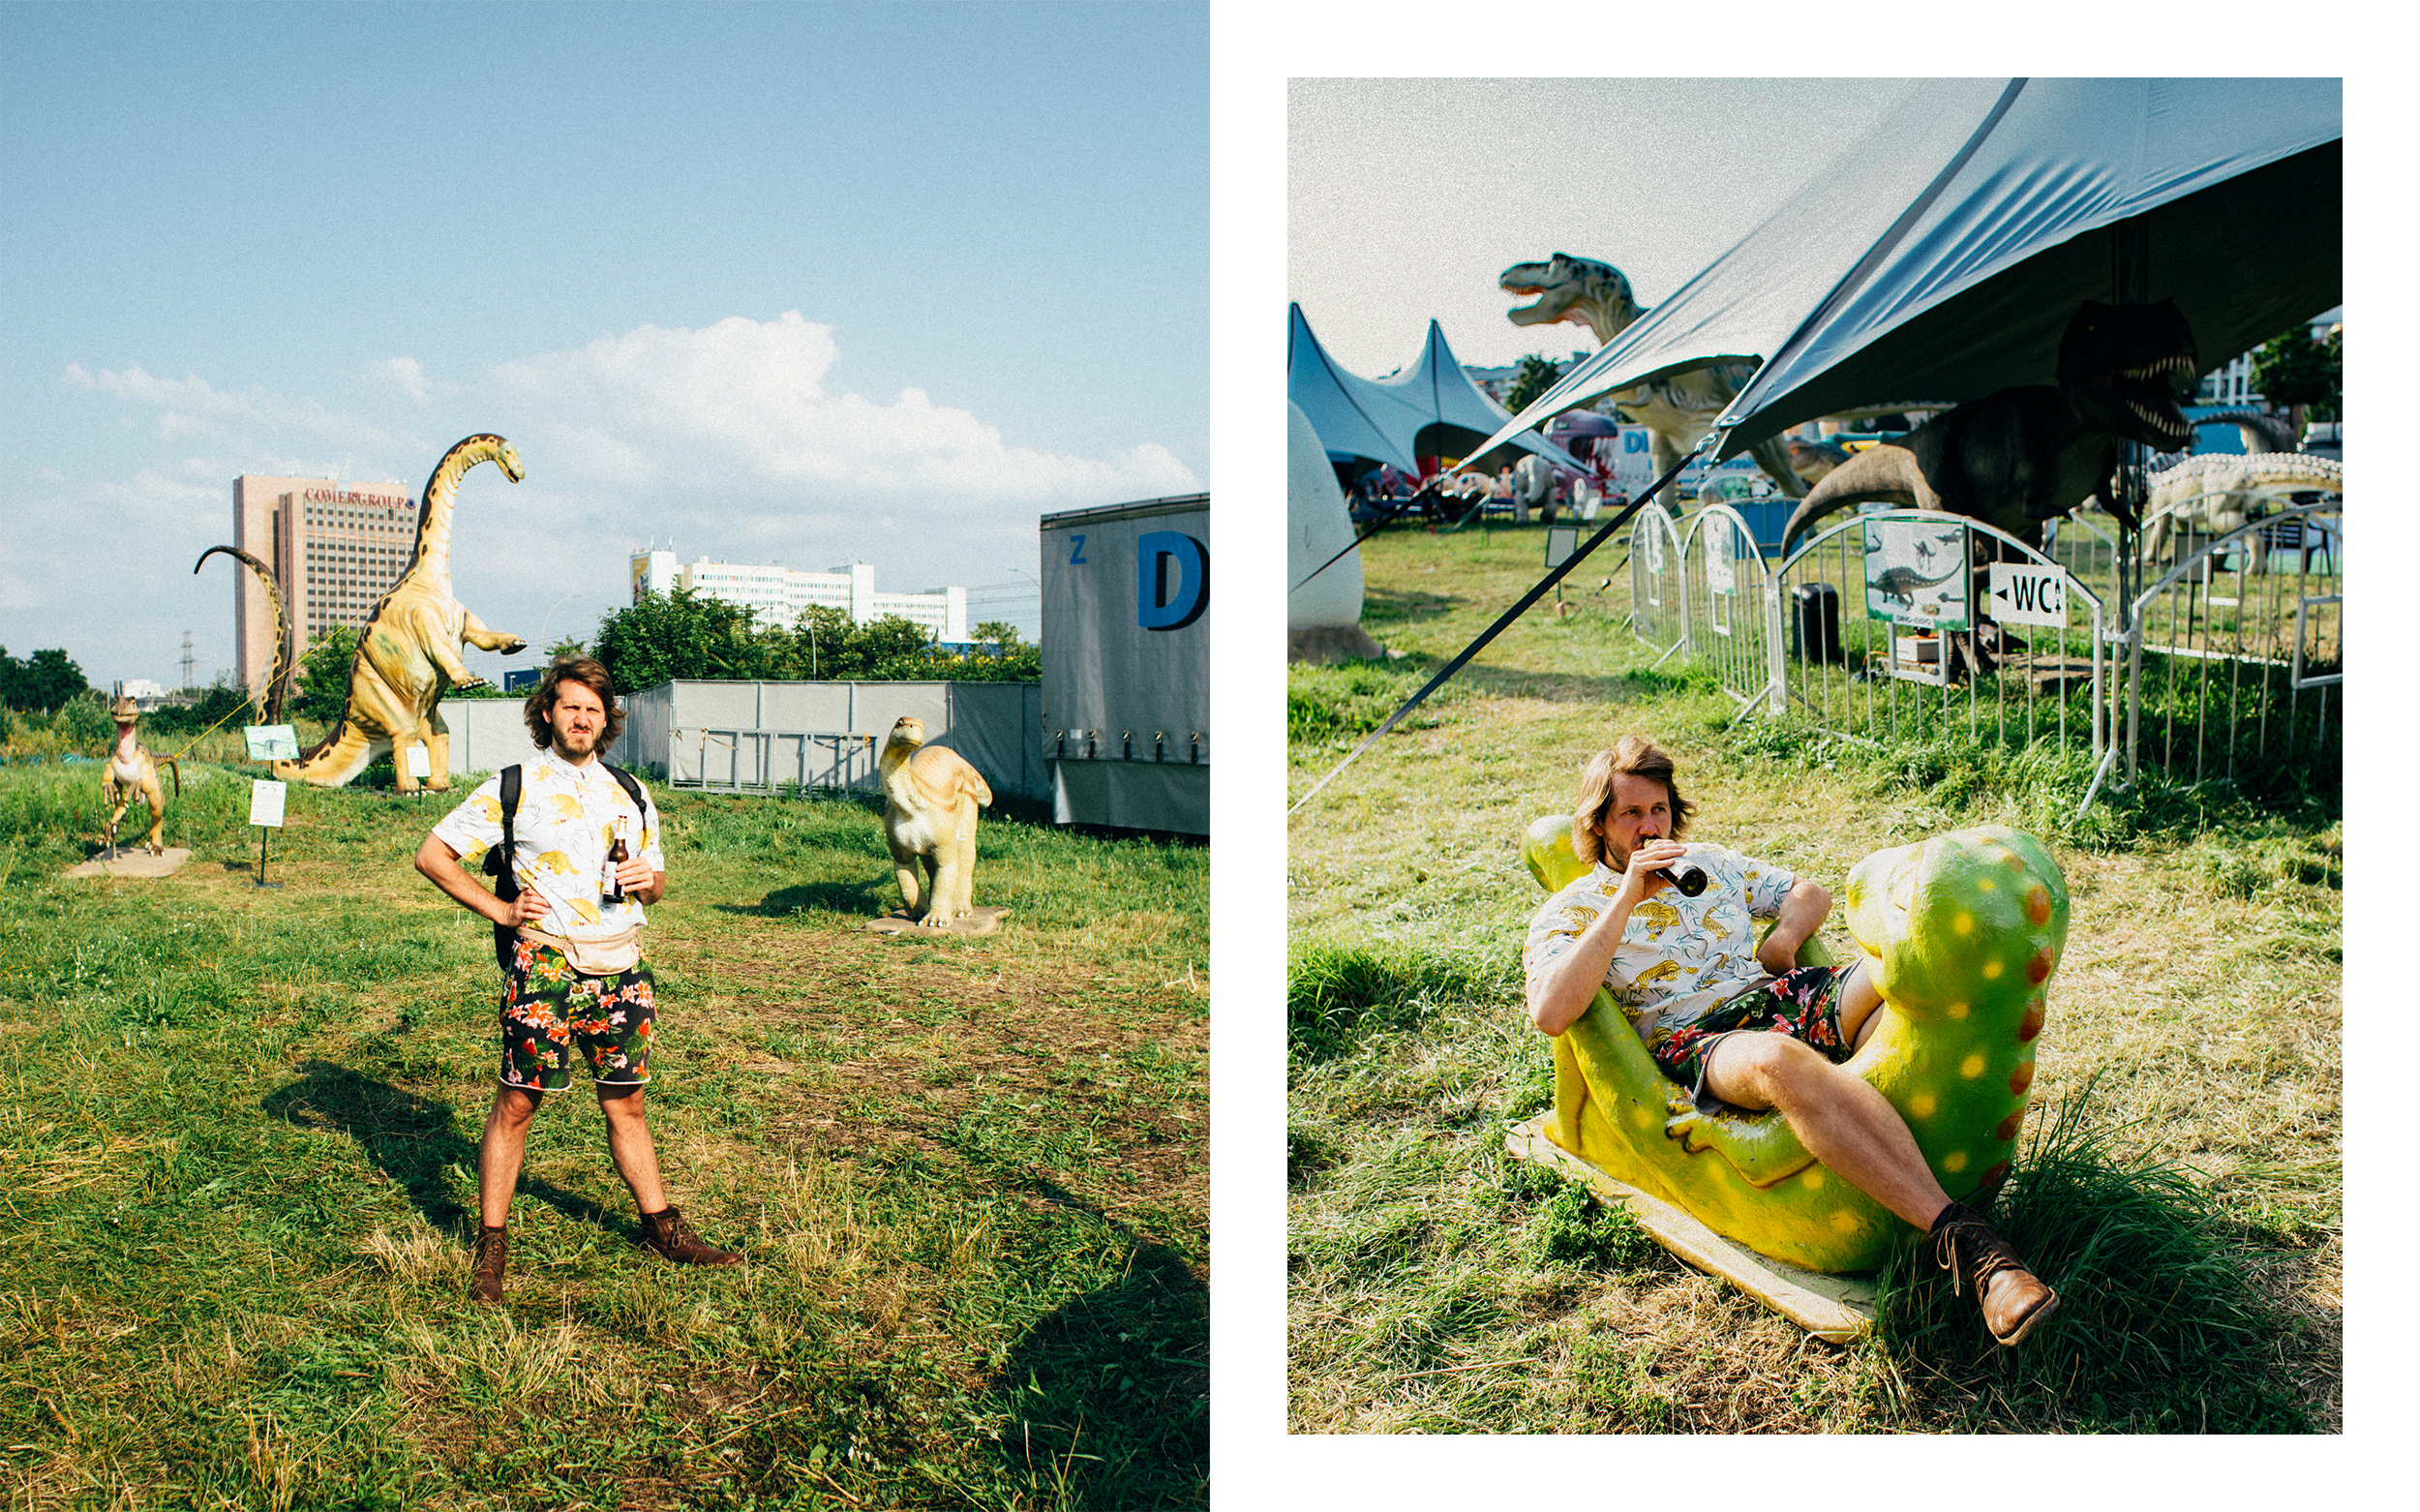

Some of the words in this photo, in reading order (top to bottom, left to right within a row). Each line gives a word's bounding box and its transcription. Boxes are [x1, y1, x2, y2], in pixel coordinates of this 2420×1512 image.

[1070, 534, 1087, 565] Z
[1137, 530, 1210, 632] D
[2012, 575, 2052, 613] WC
